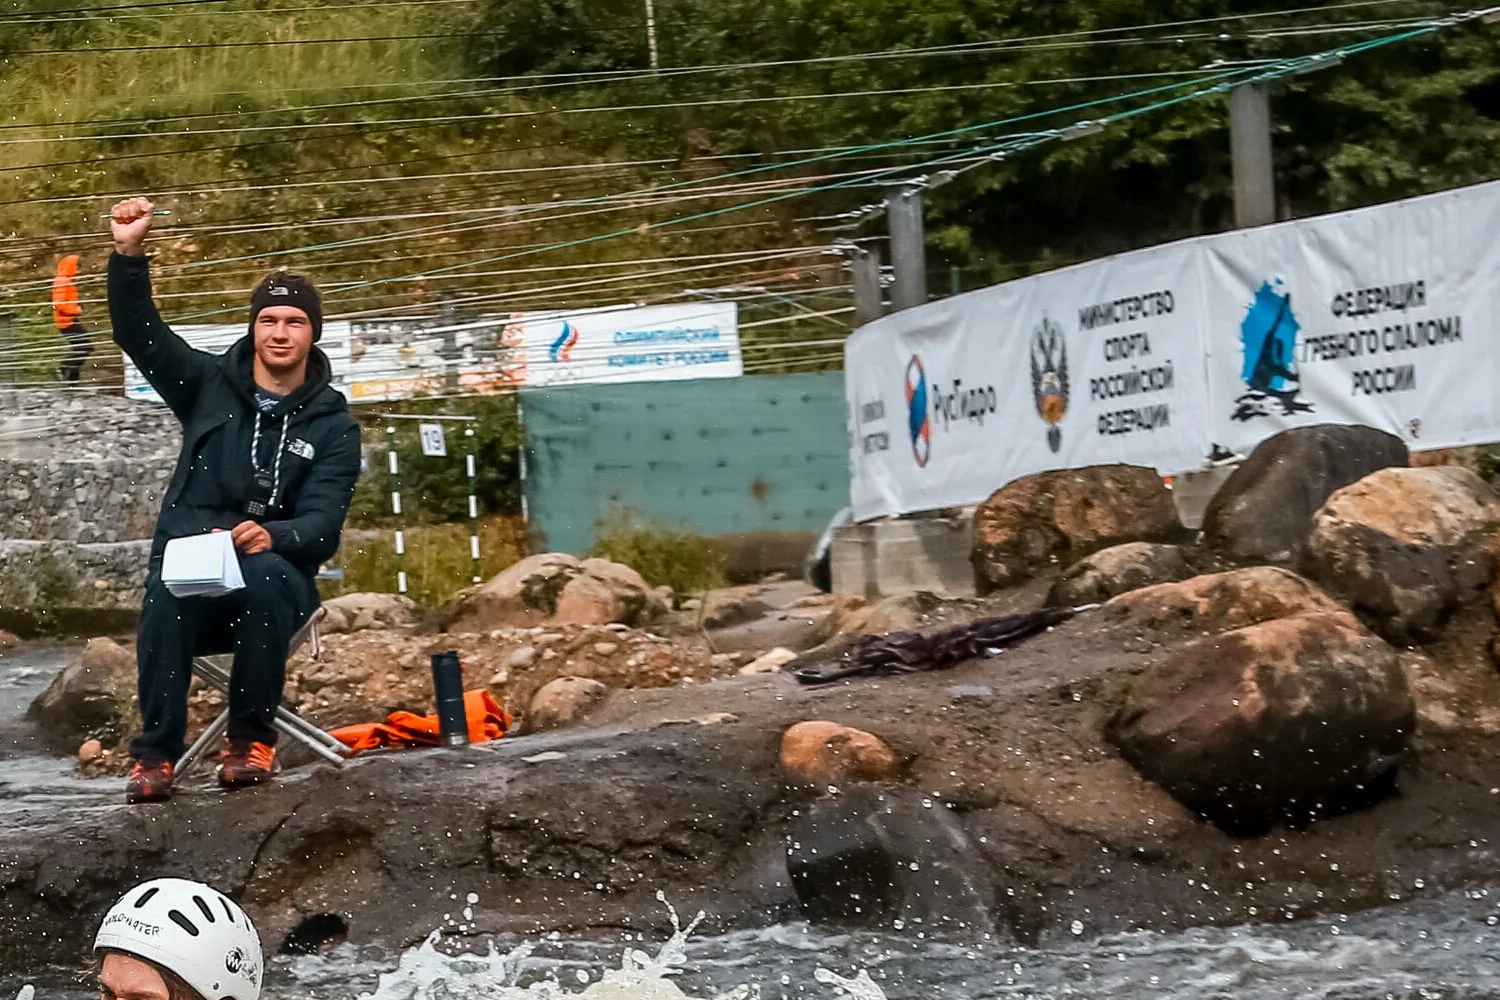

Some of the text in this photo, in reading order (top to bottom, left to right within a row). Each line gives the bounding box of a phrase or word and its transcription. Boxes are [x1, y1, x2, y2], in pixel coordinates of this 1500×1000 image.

[1078, 289, 1175, 331] МИНИСТЕРСТВО
[1331, 280, 1426, 318] ФЕДЕРАЦИЯ
[1103, 331, 1152, 362] СПОРТА
[1303, 315, 1464, 363] ГРЕБНОГО СЛАЛОМА
[1089, 357, 1175, 401] РОССИЙСКОЙ
[1352, 363, 1417, 396] РОССИИ
[932, 379, 997, 433] РусГидро
[1098, 403, 1171, 436] ФЕДЕРАЦИИ
[423, 429, 443, 451] 19
